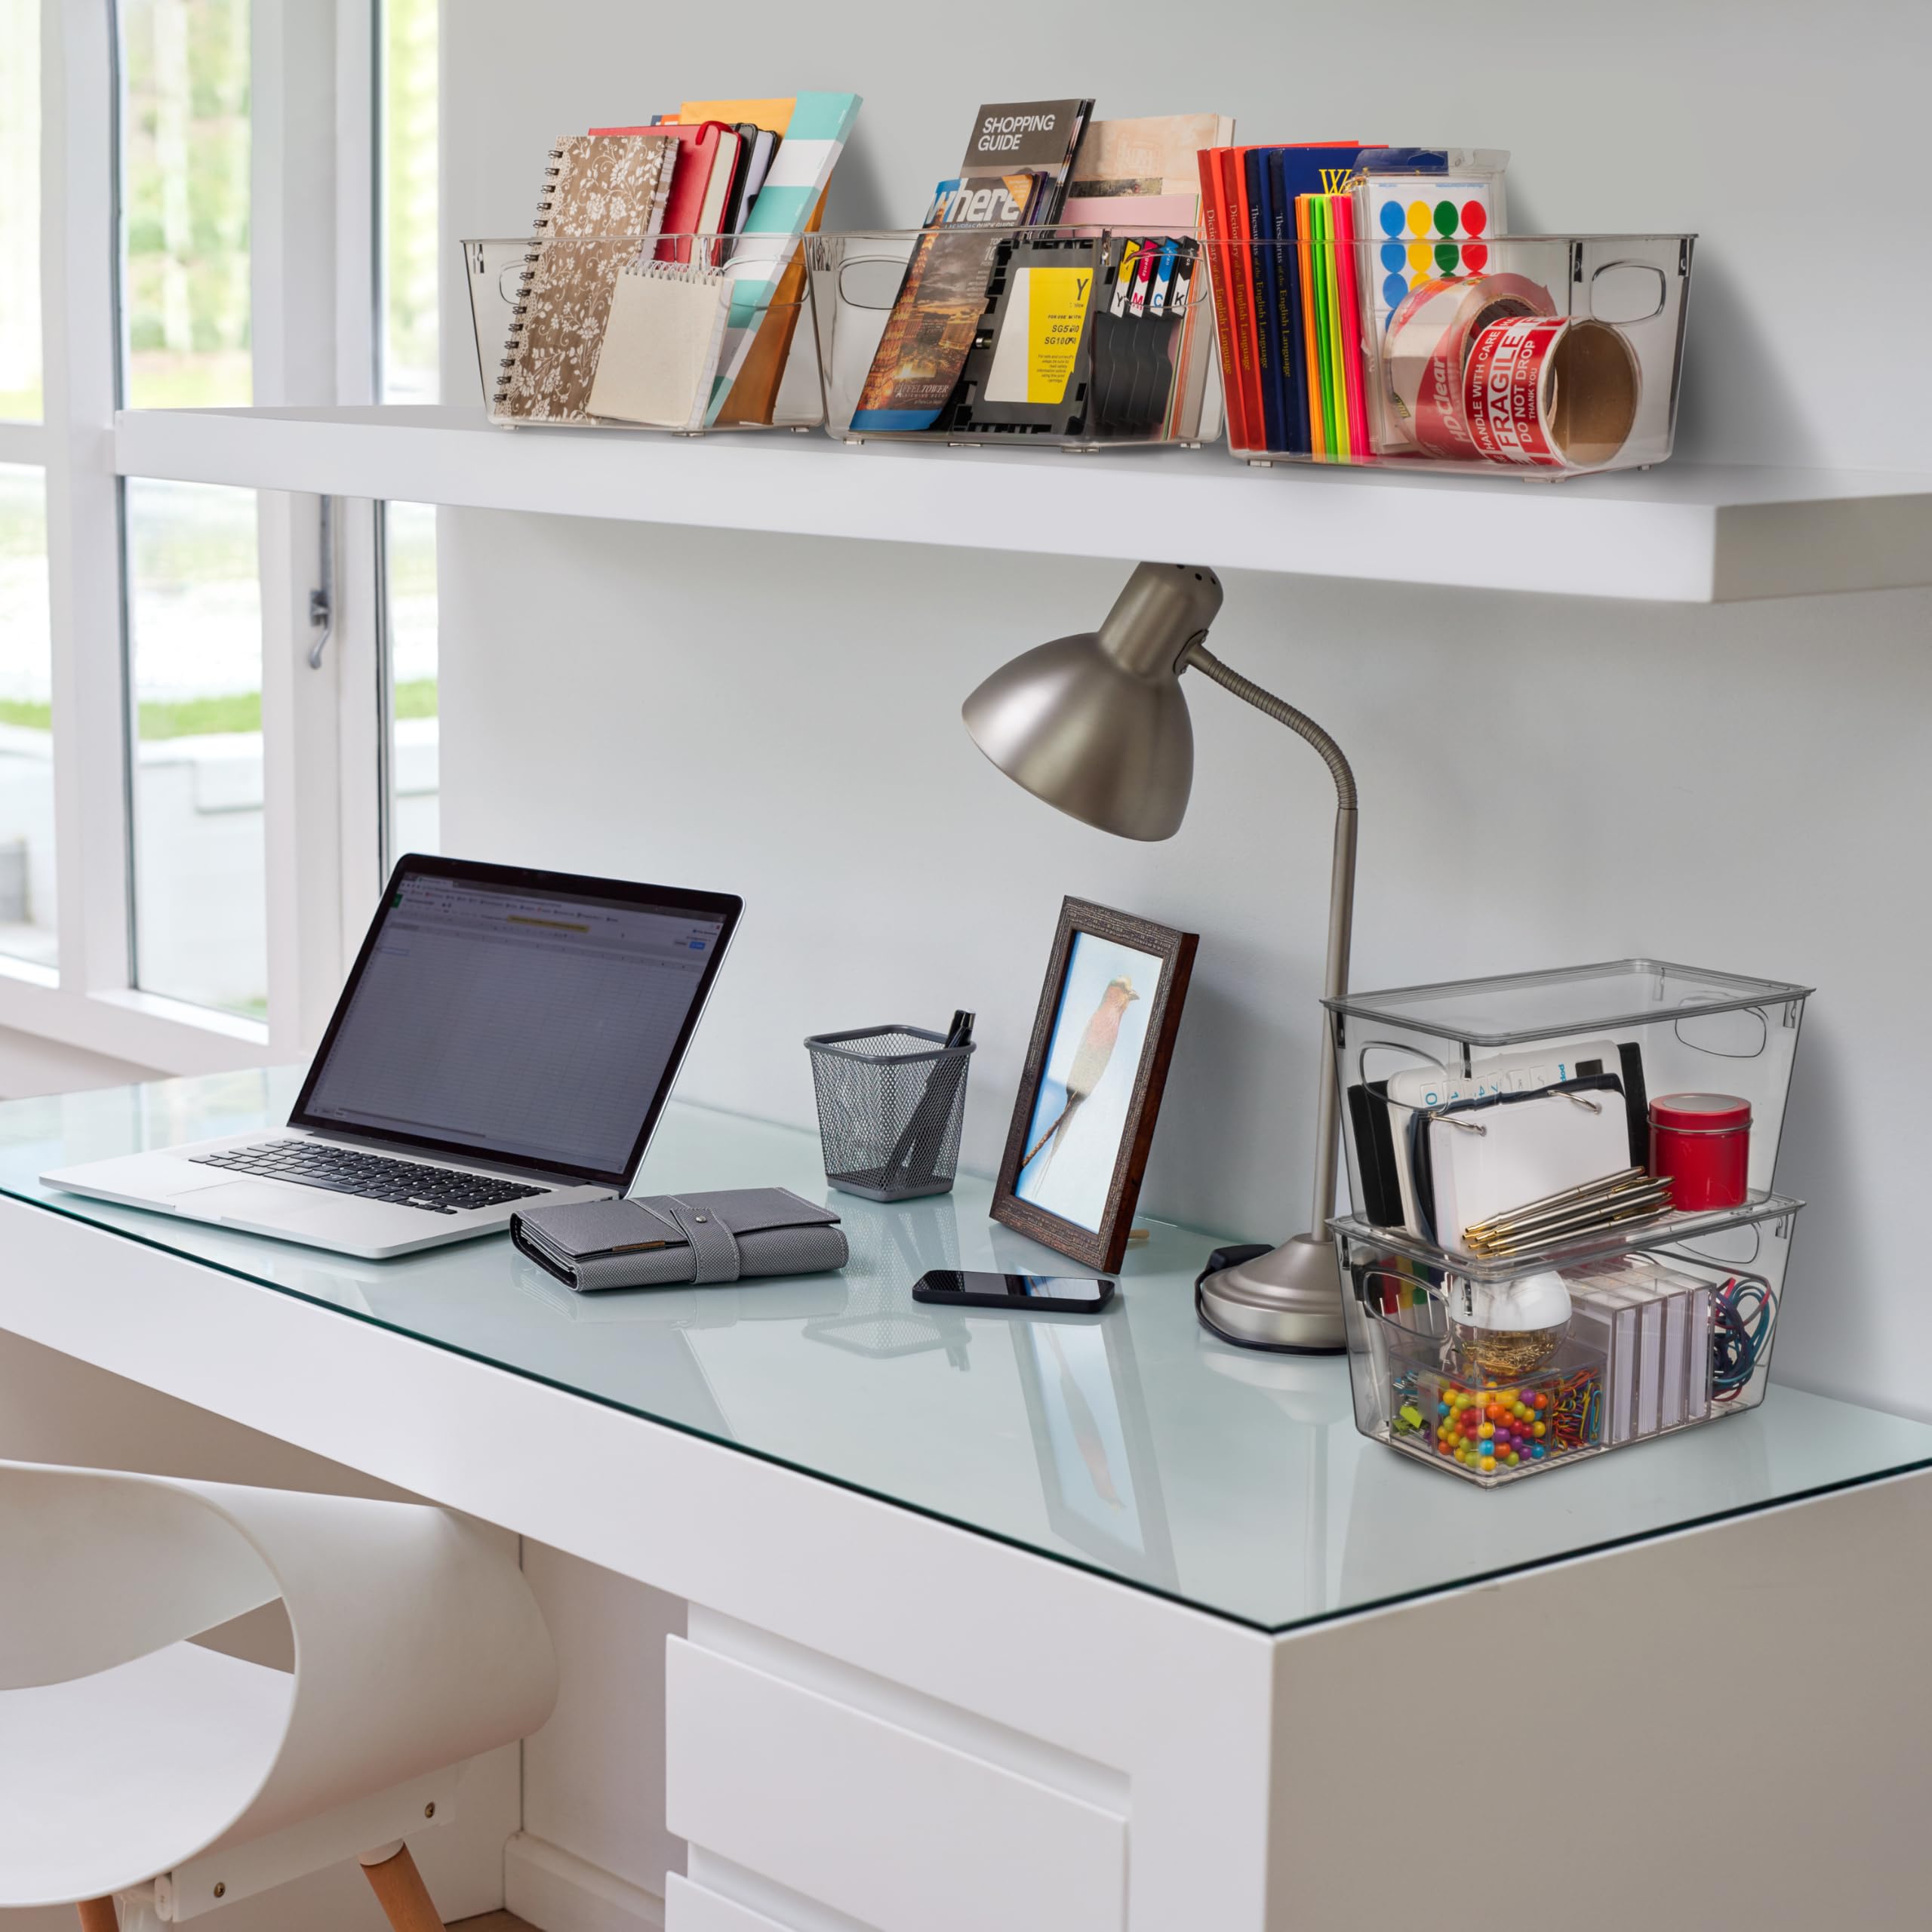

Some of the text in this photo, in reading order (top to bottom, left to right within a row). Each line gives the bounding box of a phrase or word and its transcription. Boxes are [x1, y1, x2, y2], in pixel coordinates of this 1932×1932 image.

[978, 134, 1022, 151] GUIDE
[983, 115, 1055, 134] SHOPPING
[924, 177, 1020, 224] where
[1207, 210, 1218, 262] Dictionary
[1229, 205, 1238, 257] Dictionary
[1275, 212, 1284, 263] Thesaurus
[1077, 278, 1089, 301] Y
[1117, 292, 1124, 307] Y
[1133, 292, 1143, 310] M
[1154, 294, 1163, 308] C
[1174, 292, 1185, 306] K
[1216, 288, 1227, 325] English
[1237, 284, 1247, 320] English
[1256, 281, 1266, 318] English
[1279, 290, 1289, 326] English
[1220, 328, 1232, 374] Language
[1240, 323, 1250, 371] Language
[1258, 322, 1268, 368] Language
[1281, 330, 1291, 377] Language
[1515, 340, 1536, 382] DROP
[921, 385, 949, 393] TOWER
[1472, 331, 1500, 451] HANDLE WITH CARE
[1491, 334, 1524, 448] FRAGILE
[1513, 385, 1526, 418] NOT
[1524, 368, 1537, 420] THANK YOU
[1517, 421, 1533, 444] DO
[1451, 1091, 1459, 1100] 1
[1478, 1085, 1485, 1097] 4
